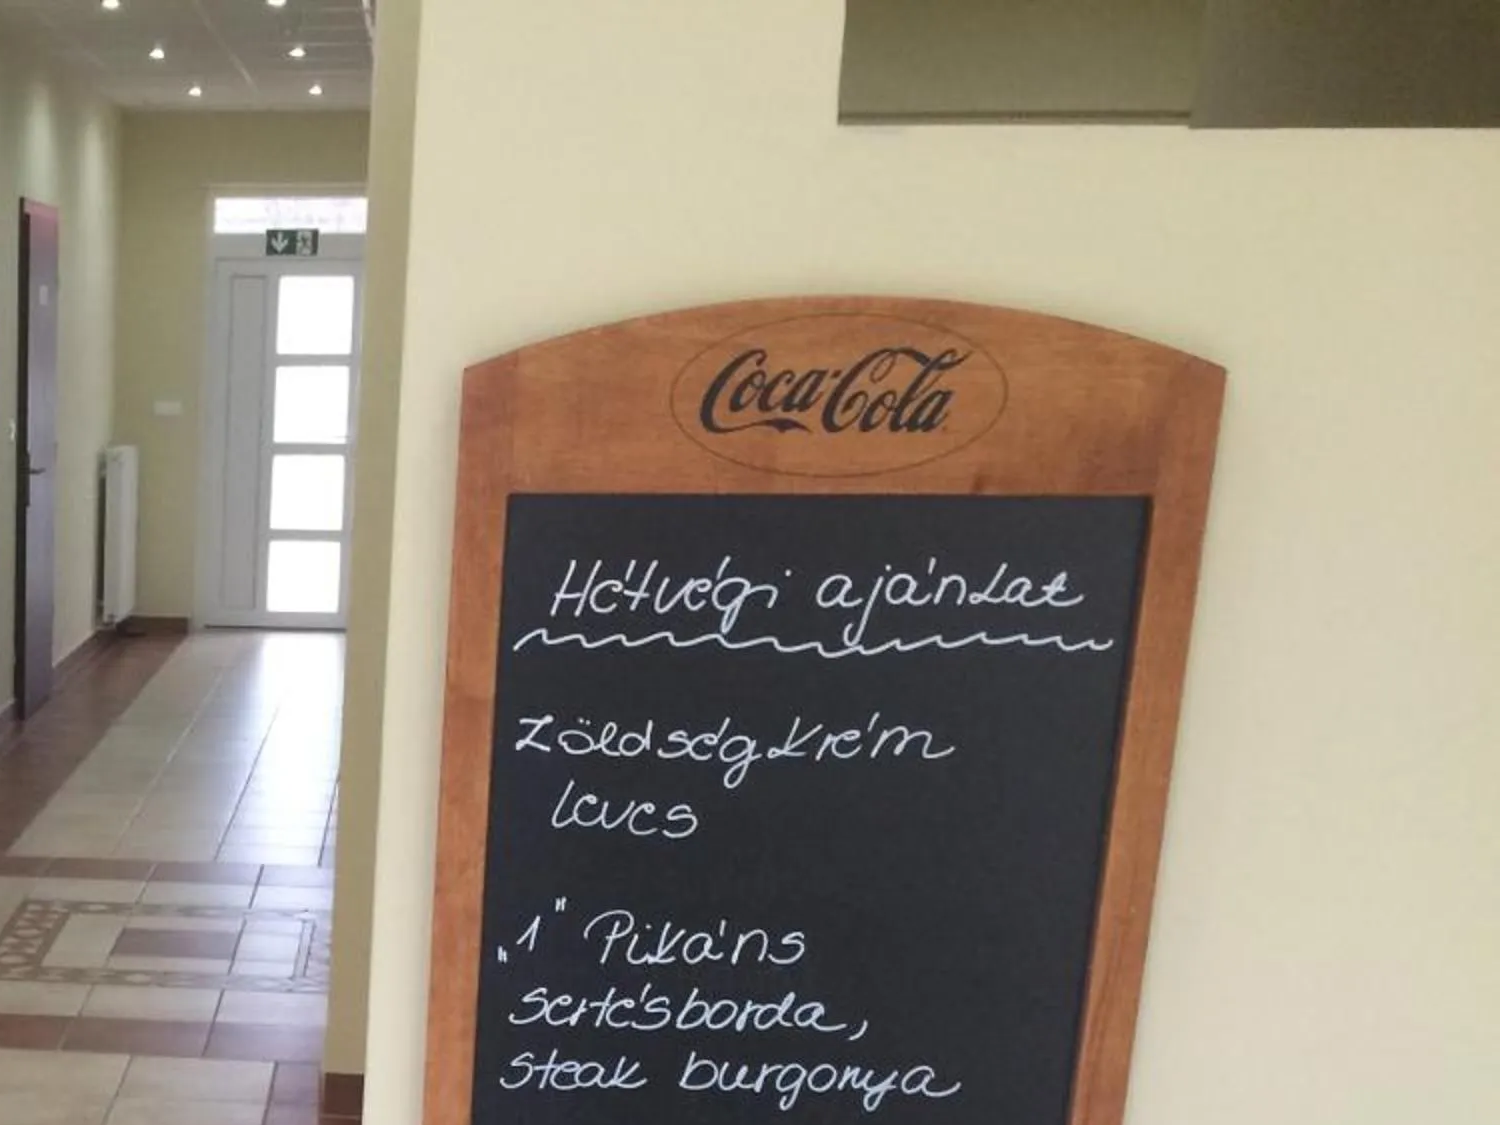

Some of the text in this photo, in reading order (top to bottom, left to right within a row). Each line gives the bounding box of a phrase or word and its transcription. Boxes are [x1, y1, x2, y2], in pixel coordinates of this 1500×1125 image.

[700, 346, 972, 434] Coca-Cola
[549, 556, 1085, 648] Hétvégi ajánlat
[552, 780, 697, 838] leves
[584, 910, 804, 964] Pikáns
[500, 1049, 961, 1111] steak burgonya
